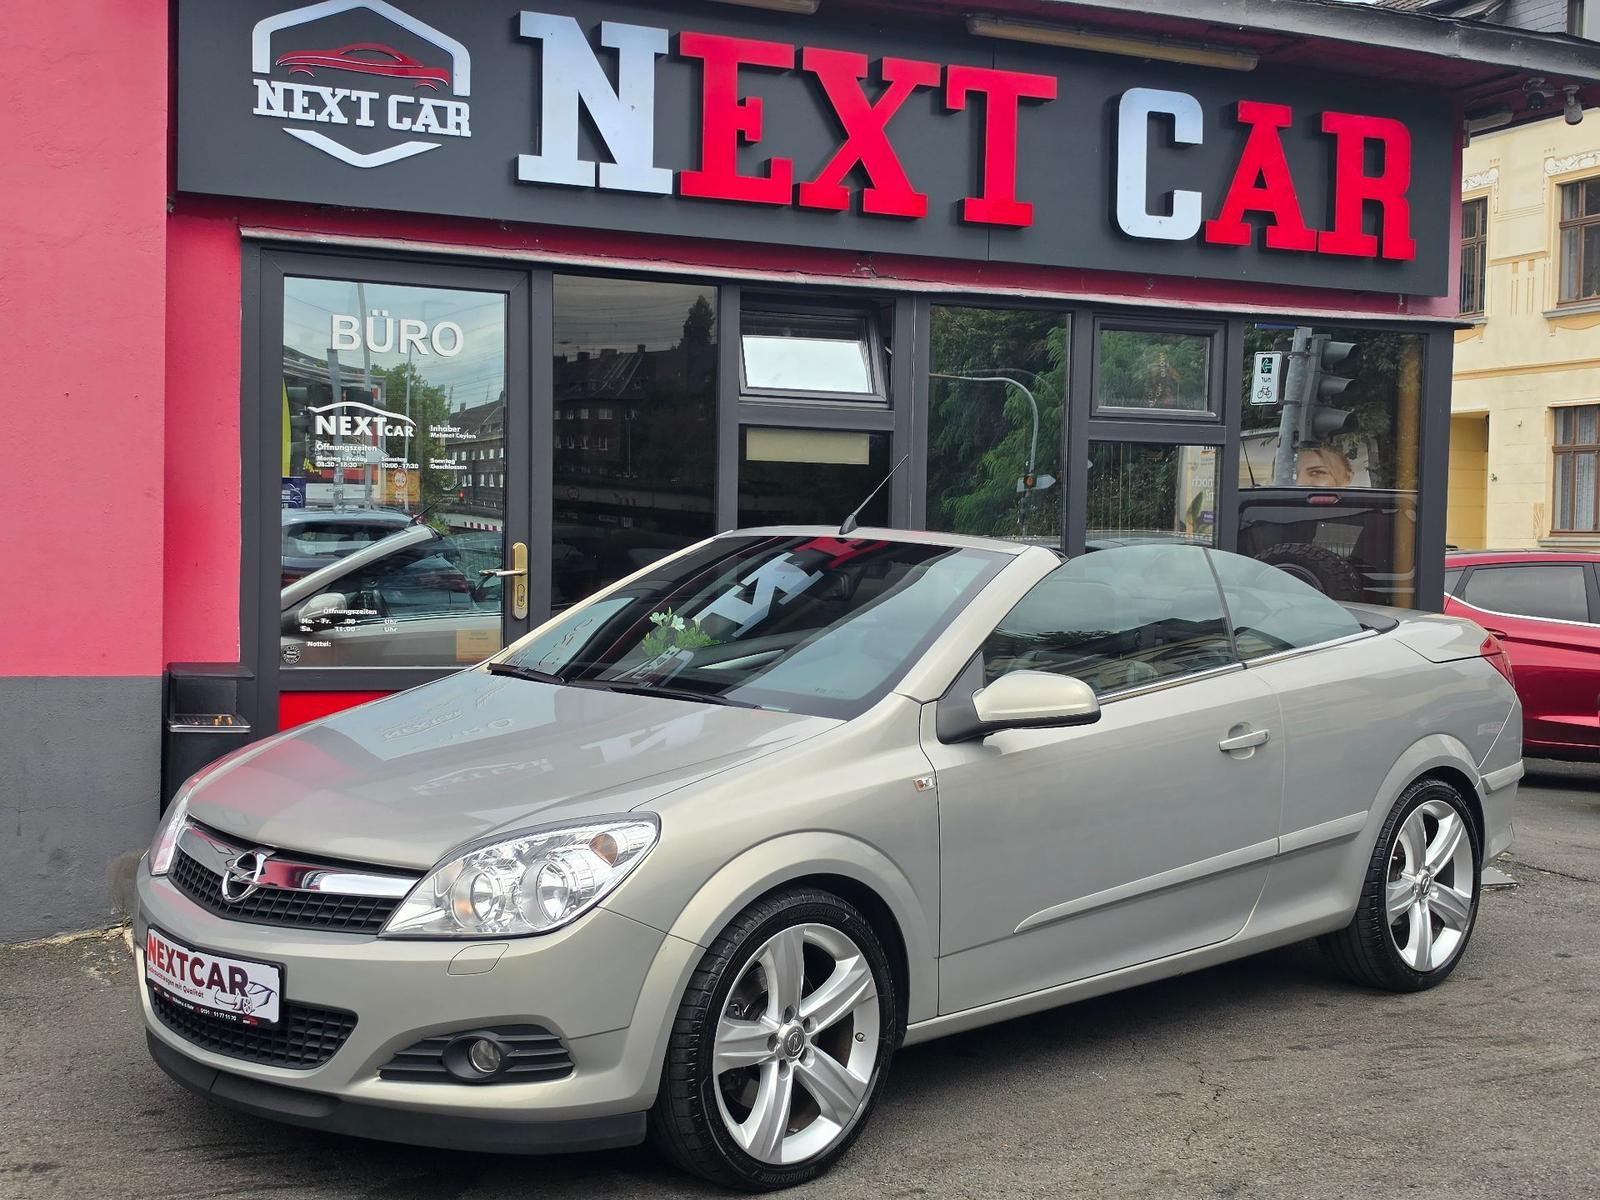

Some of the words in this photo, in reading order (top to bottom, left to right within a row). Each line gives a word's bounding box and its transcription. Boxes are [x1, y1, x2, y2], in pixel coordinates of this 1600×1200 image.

[252, 78, 379, 127] NEXT
[387, 93, 471, 137] CAR
[517, 10, 1057, 228] NEXT
[1116, 87, 1416, 261] CAR
[331, 309, 464, 357] BÜRO
[316, 440, 377, 452] Öffnungszeiten
[429, 424, 461, 433] Inhaber
[148, 933, 249, 997] NEXTCAR
[183, 985, 204, 999] Qualität
